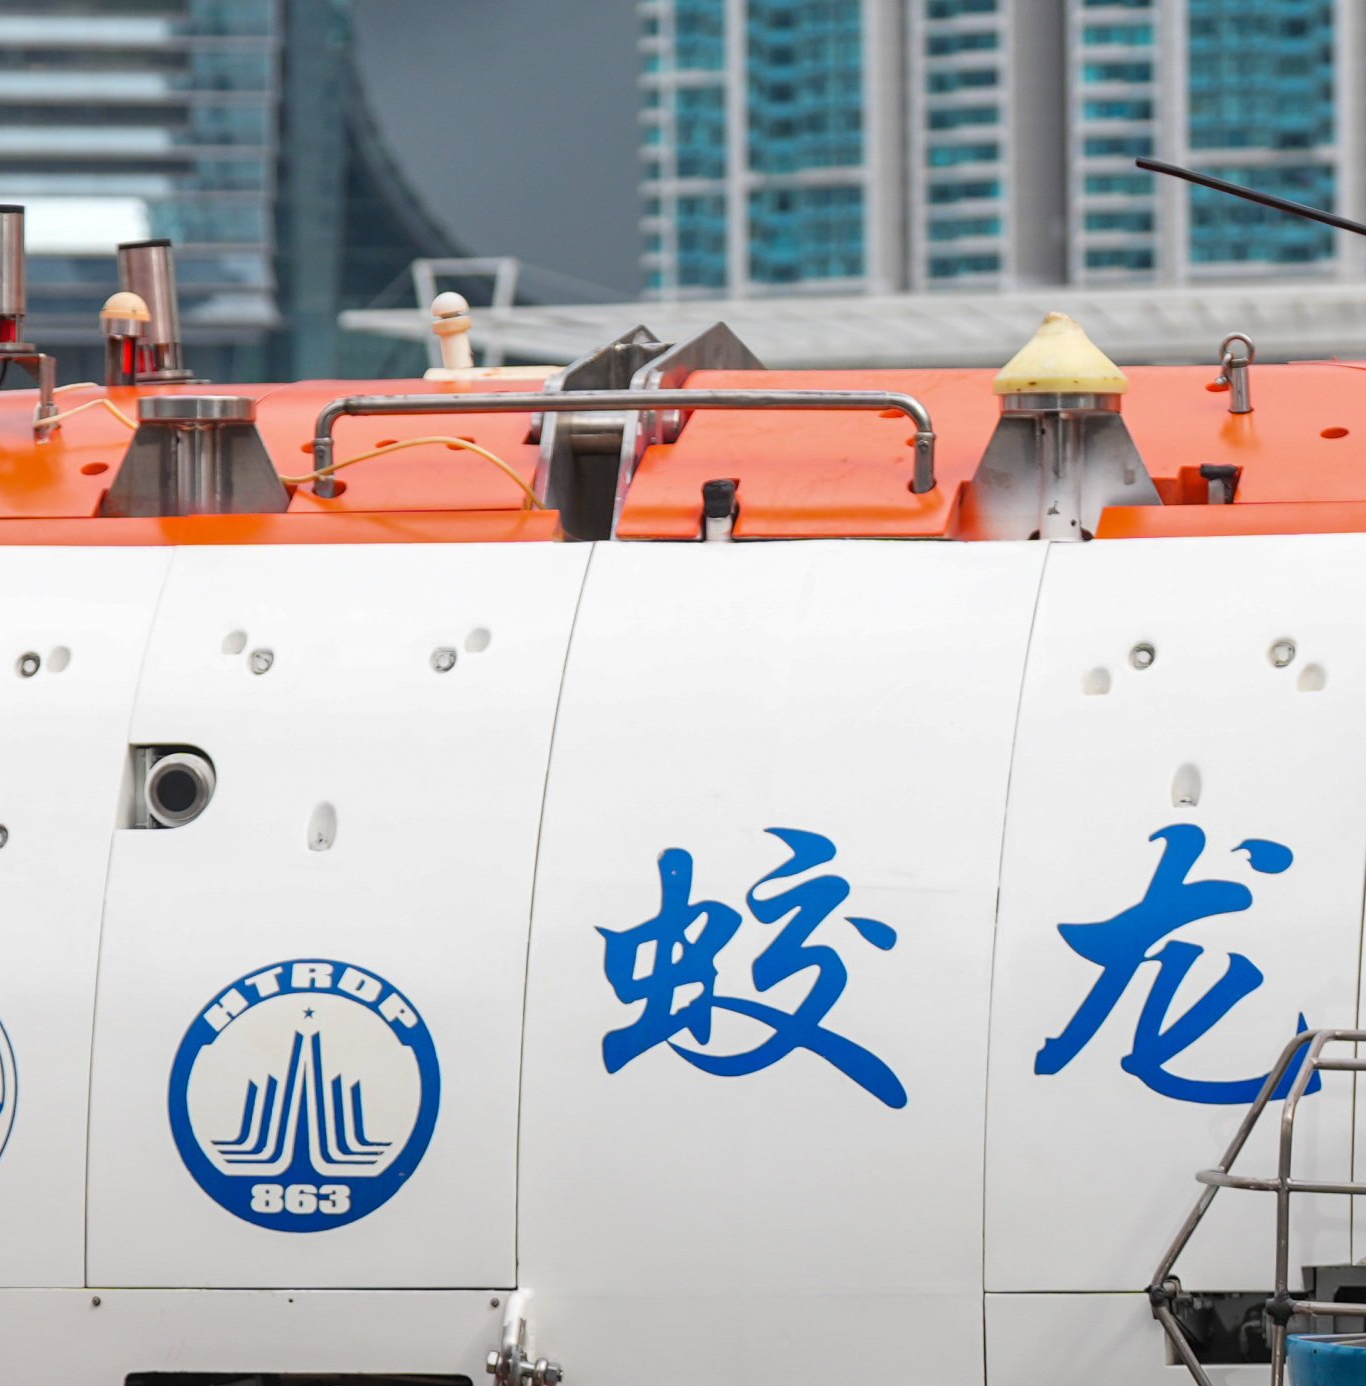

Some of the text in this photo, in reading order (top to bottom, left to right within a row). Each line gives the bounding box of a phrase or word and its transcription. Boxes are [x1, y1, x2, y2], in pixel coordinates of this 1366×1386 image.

[202, 962, 419, 1032] HTRDP
[594, 822, 1321, 1109] 蛟龙
[250, 1183, 351, 1215] 863
